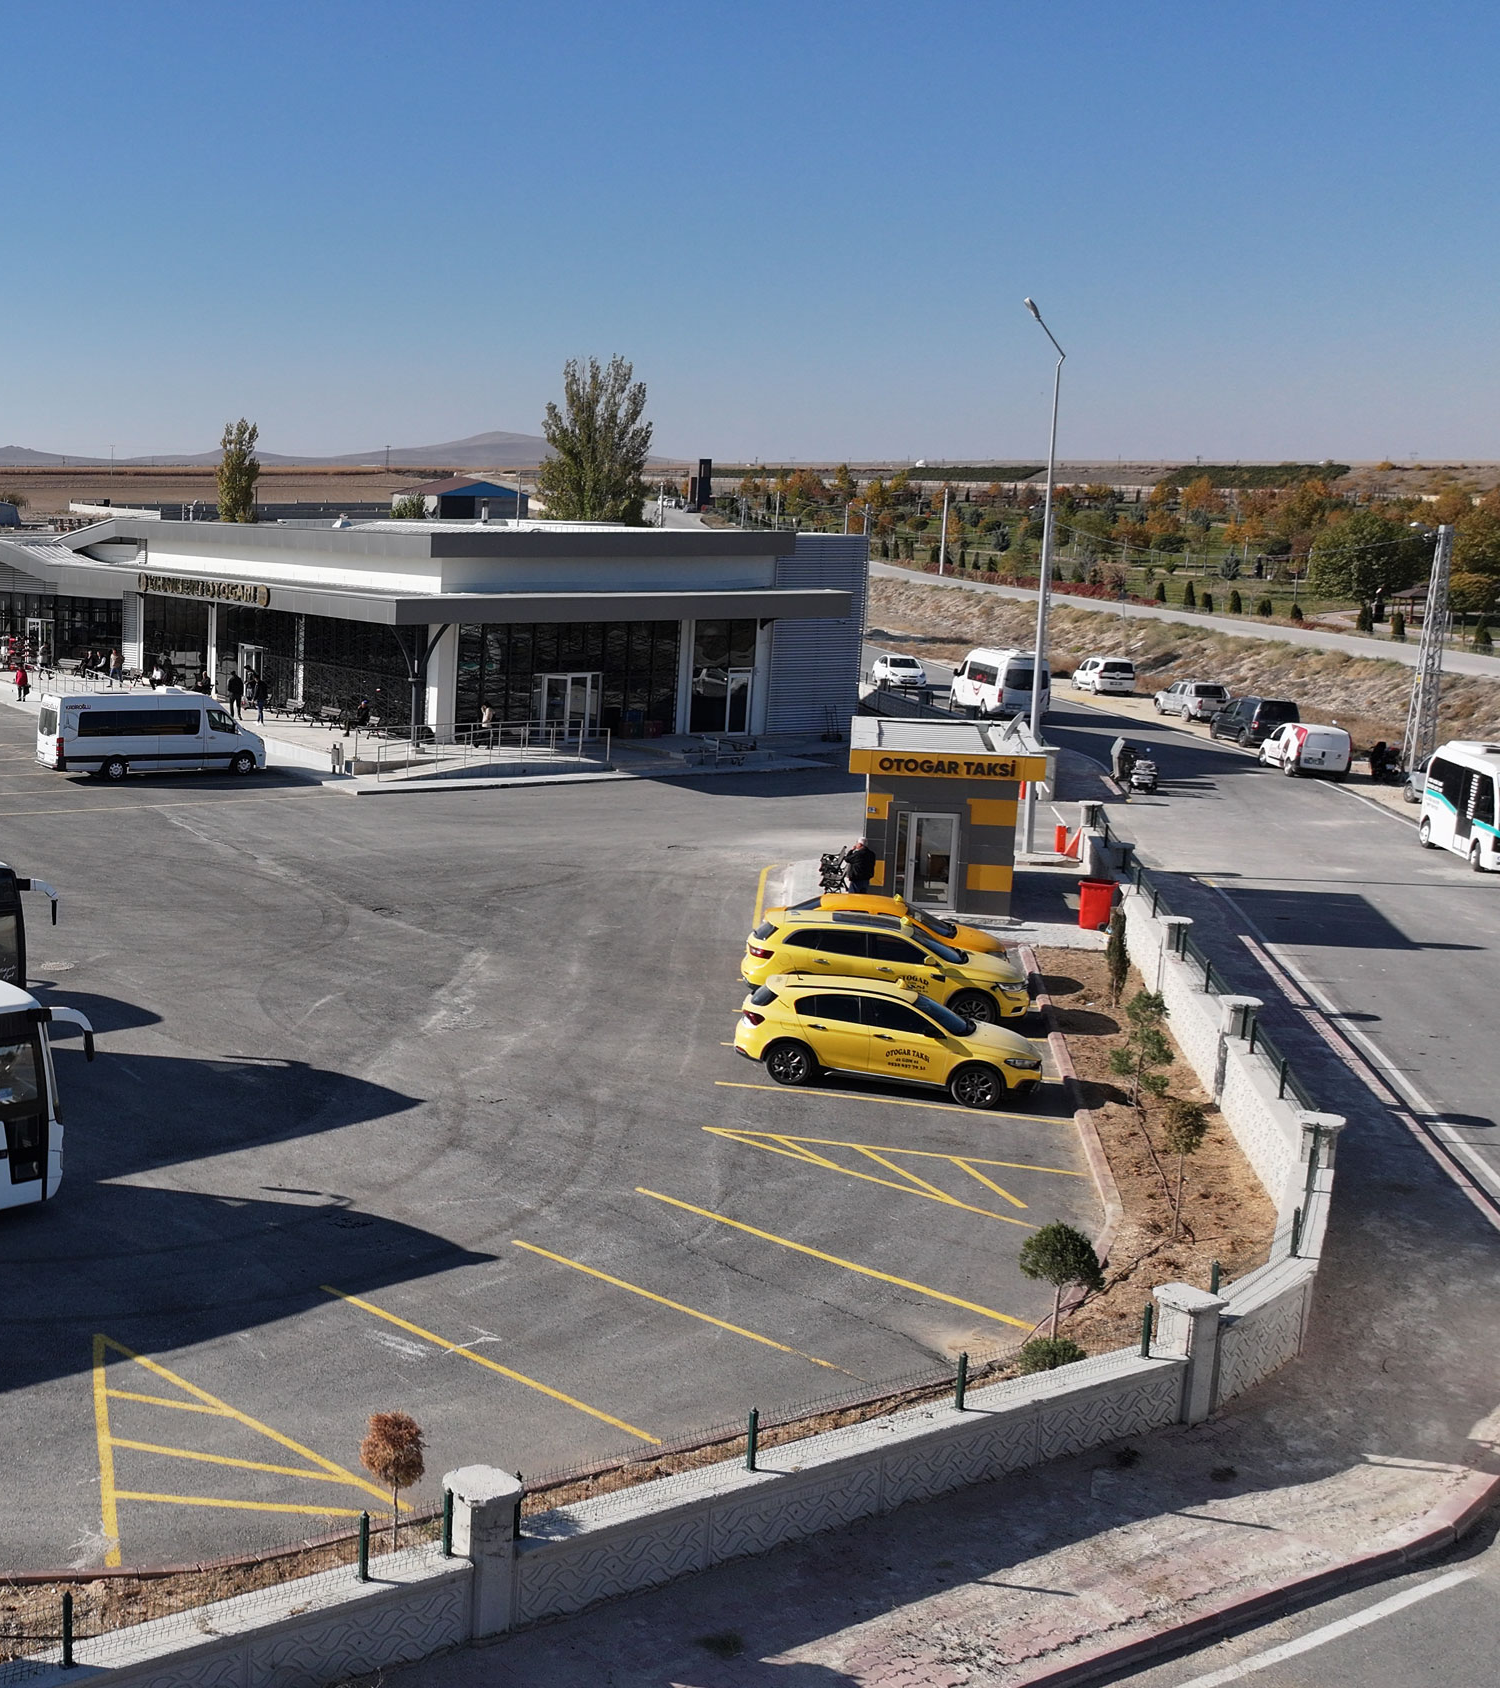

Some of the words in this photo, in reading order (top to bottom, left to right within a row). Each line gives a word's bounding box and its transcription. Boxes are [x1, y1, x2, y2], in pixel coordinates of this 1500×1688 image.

[878, 756, 960, 776] OTOGAR
[963, 759, 1017, 777] TAKSİ
[885, 1048, 911, 1058] OTOGAR
